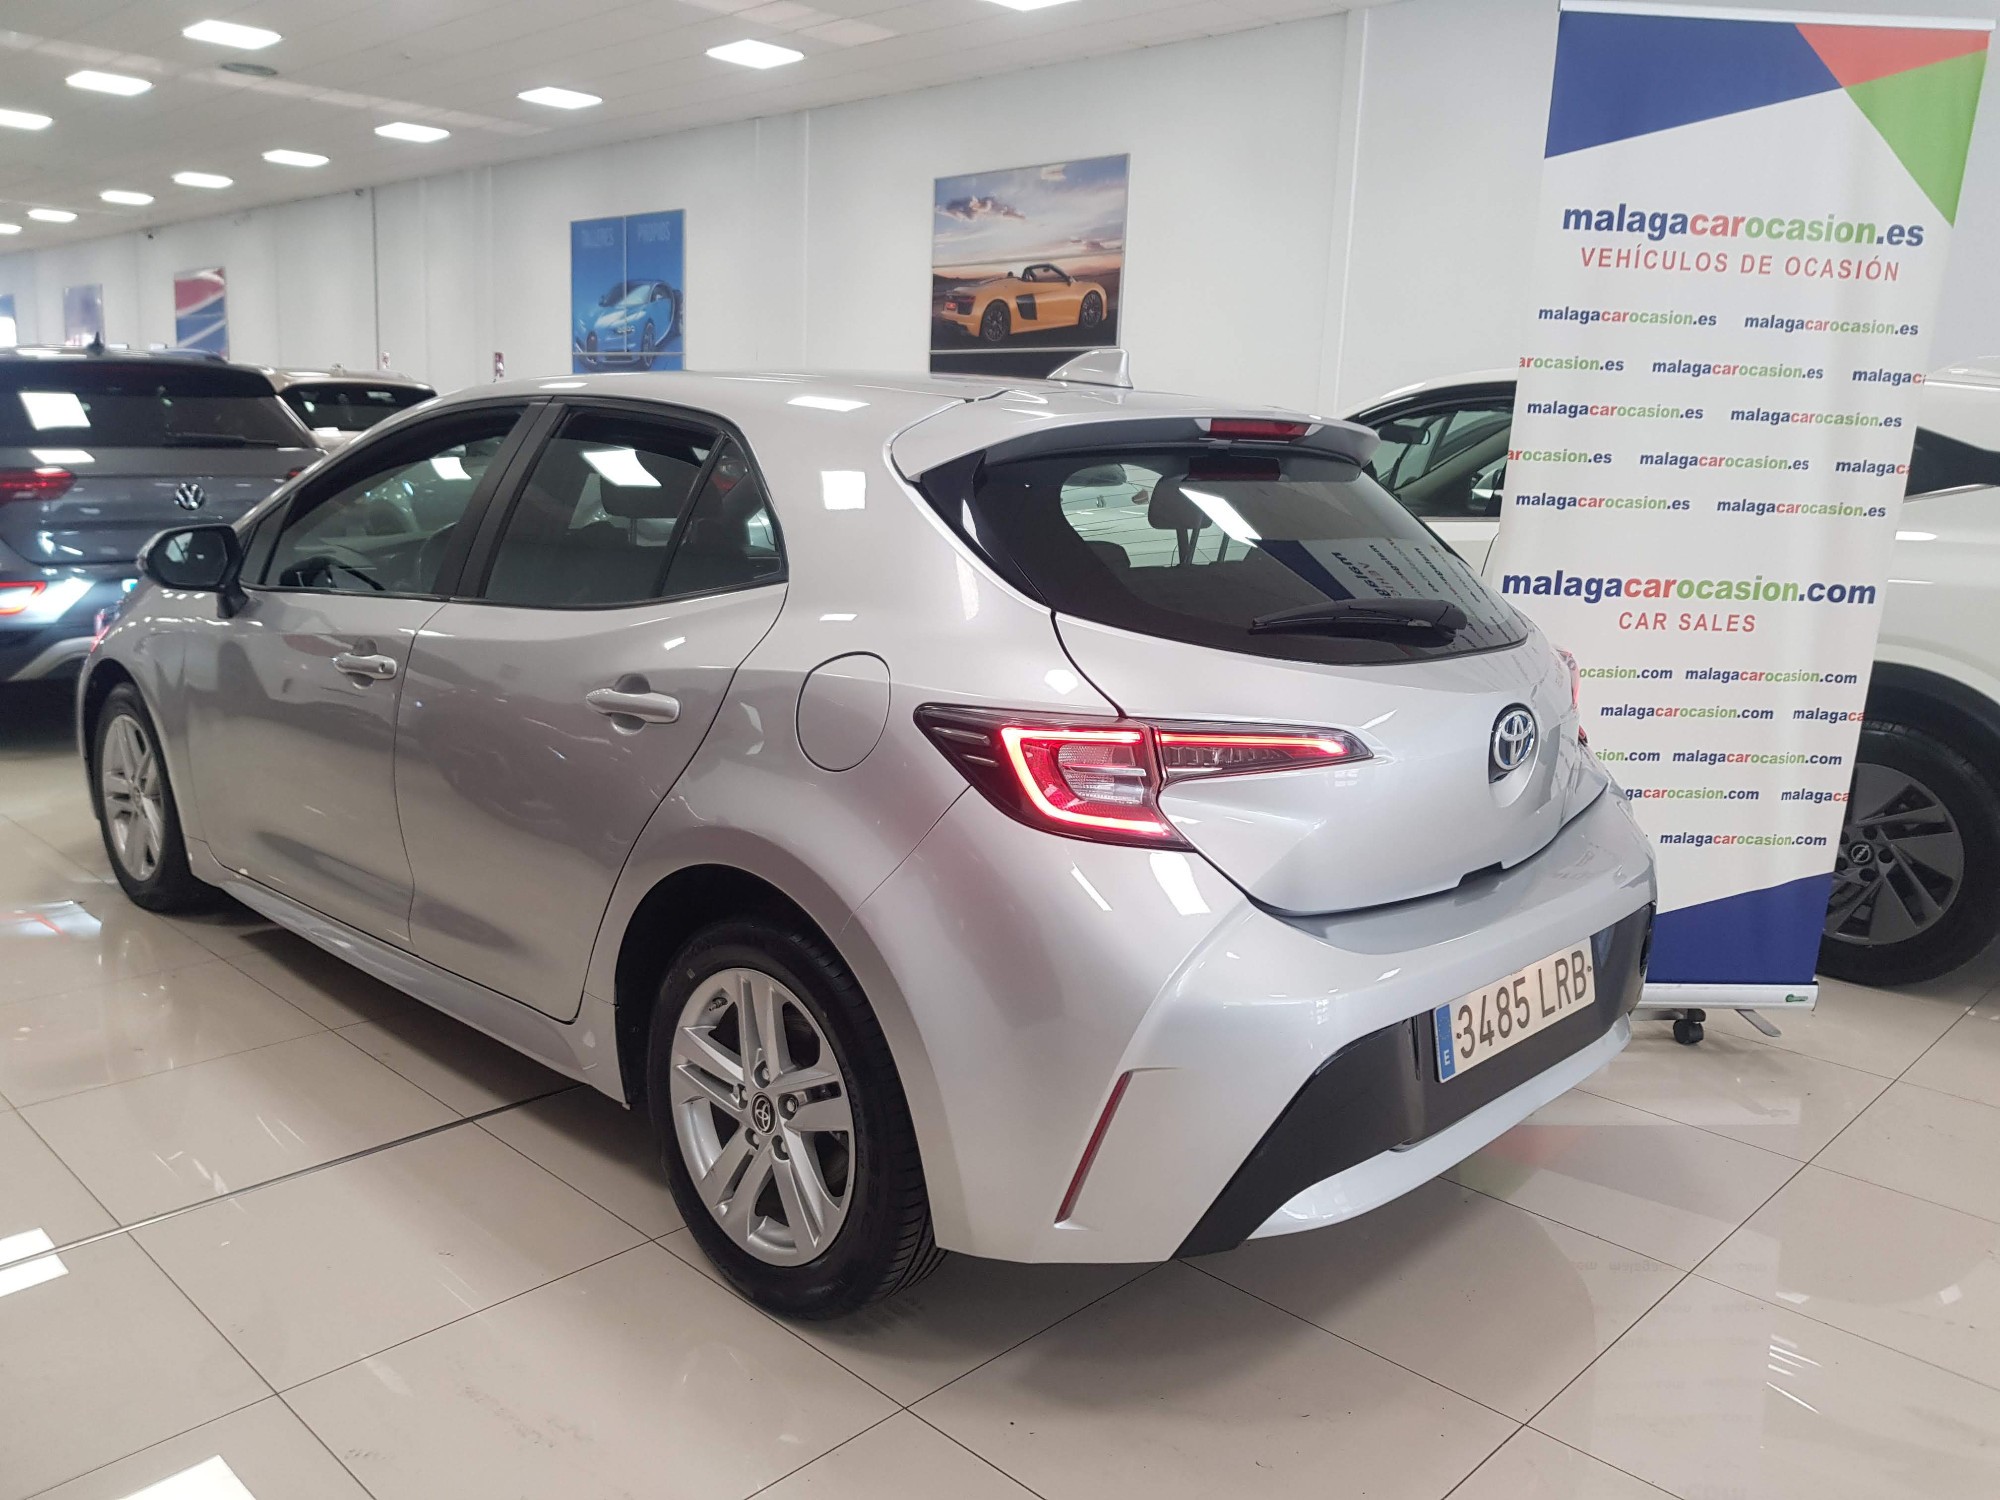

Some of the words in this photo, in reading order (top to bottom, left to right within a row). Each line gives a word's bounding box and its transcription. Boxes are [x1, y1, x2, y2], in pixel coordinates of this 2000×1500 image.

[1562, 204, 1924, 247] malagacarocasion.es
[1580, 244, 1727, 272] VEHÍCULOS
[1740, 254, 1772, 275] DE
[1785, 256, 1900, 282] OCASIÓN
[1538, 306, 1717, 327] malagacarocasion.es
[1744, 314, 1919, 337] malagacarocasion.es
[1651, 359, 1824, 380] malagacarocasion.es
[1527, 401, 1703, 420] malagacarocasion.es
[1730, 407, 1902, 429] malagacarocasion.es
[1639, 451, 1809, 472] malagacarocasion.es
[1516, 492, 1690, 511] malagacarocasion.es
[1716, 498, 1886, 520] malagacarocasion.es
[1501, 570, 1876, 604] malagacarocasion.com
[1619, 611, 1668, 631] CAR
[1679, 613, 1757, 633] SALES
[1685, 667, 1858, 685] malagacarocasion.com
[1601, 704, 1774, 721] malagacarocasion.com
[1672, 749, 1842, 766] malagacarocasion.com
[1660, 832, 1827, 848] malagacarocasion.com
[1457, 976, 1530, 1058] 3485
[1538, 950, 1587, 1018] LRB
[1443, 1050, 1450, 1065] E
